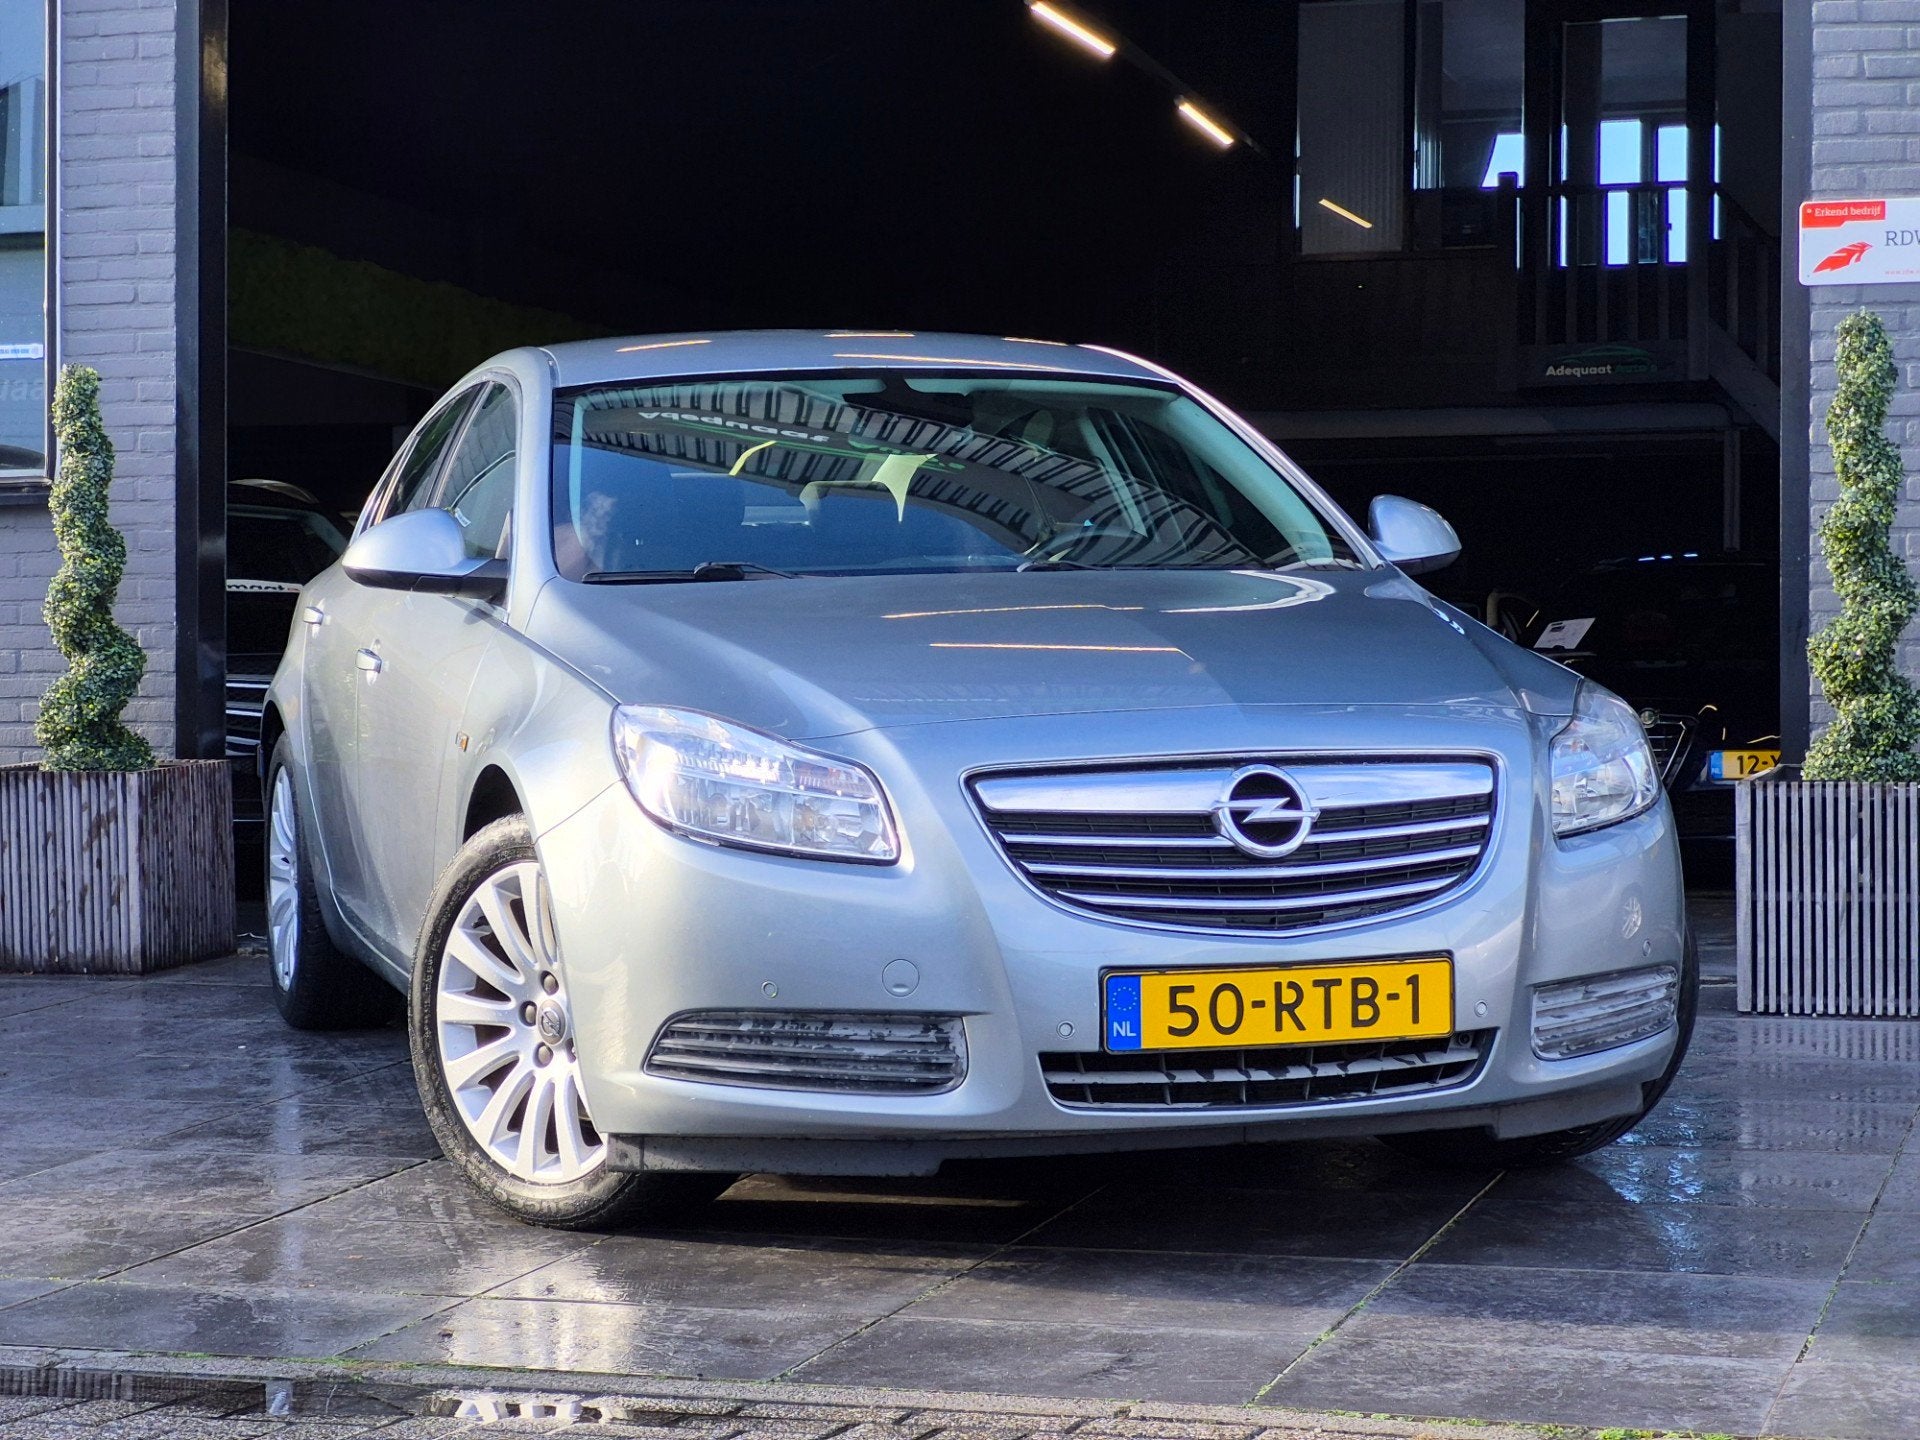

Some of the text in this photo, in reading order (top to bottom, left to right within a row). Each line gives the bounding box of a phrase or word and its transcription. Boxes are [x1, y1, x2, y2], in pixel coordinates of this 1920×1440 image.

[1814, 204, 1881, 217] Erkend bedrijf
[1545, 364, 1612, 377] Adequaat
[1167, 973, 1420, 1038] 50-RTB-1
[1112, 1021, 1137, 1038] NL
